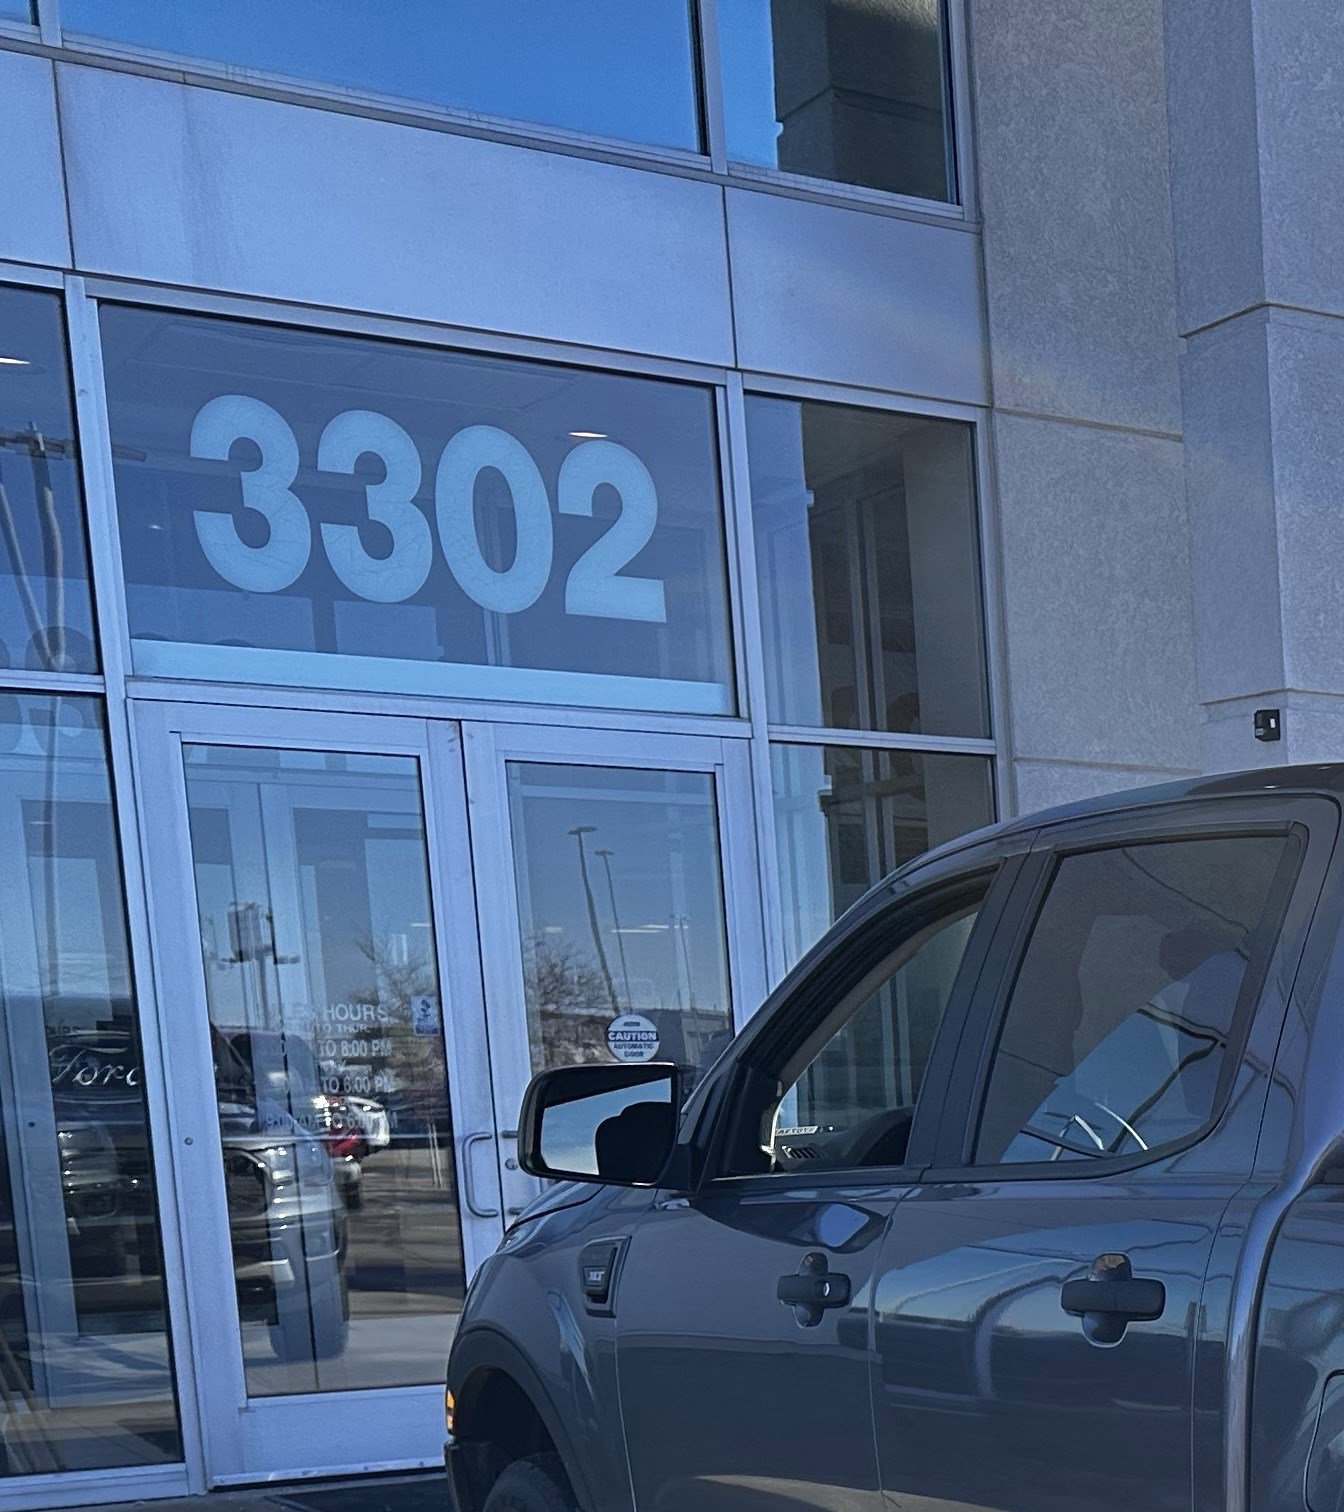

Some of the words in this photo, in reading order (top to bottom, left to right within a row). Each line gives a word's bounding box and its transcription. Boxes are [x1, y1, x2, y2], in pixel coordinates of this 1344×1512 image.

[191, 394, 667, 624] 3302
[323, 1003, 389, 1021] HOURS
[608, 1032, 657, 1041] CAUTION
[341, 1039, 368, 1057] 8:00
[371, 1039, 392, 1057] PM
